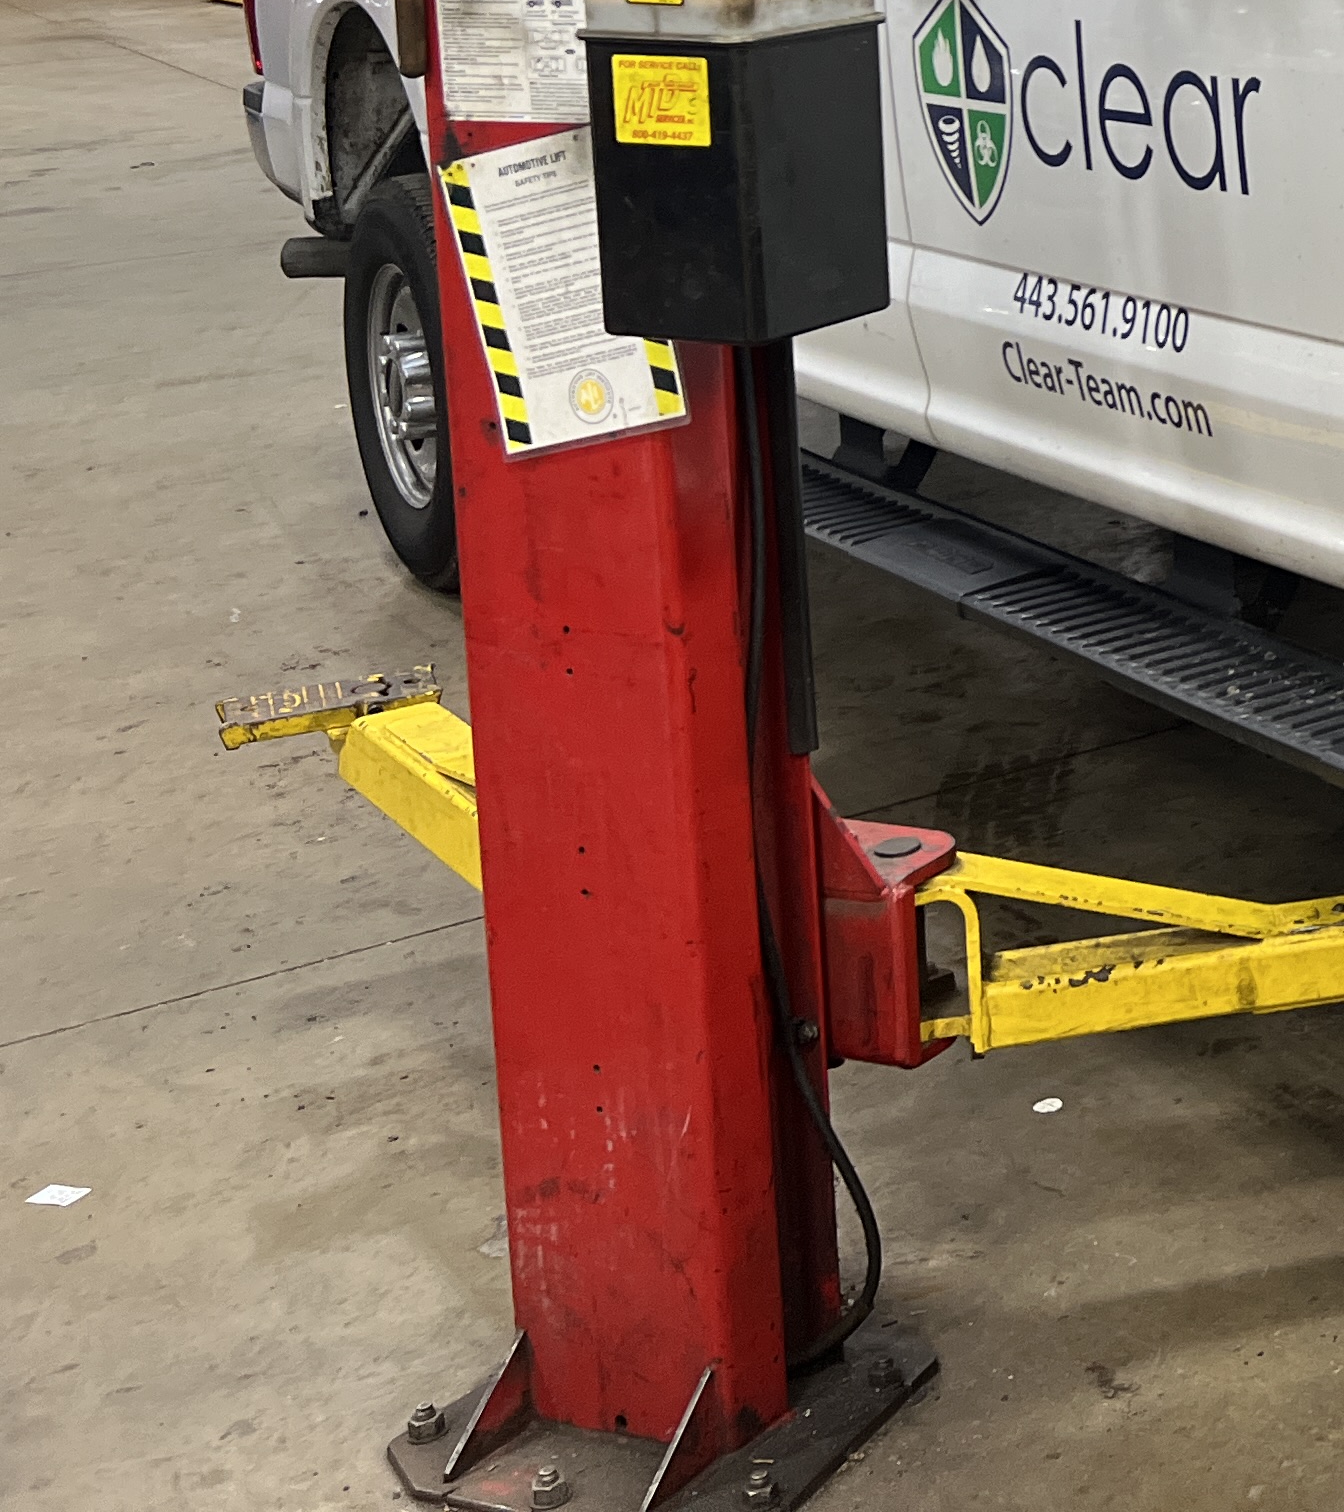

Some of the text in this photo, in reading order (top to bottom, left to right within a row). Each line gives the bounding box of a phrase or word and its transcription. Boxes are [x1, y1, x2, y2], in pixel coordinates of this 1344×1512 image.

[619, 60, 636, 69] FOR
[638, 61, 674, 70] SERVICE
[1020, 19, 1262, 196] clear
[498, 150, 567, 178] AUTOMOTIVE LIFT
[515, 170, 558, 188] SAFETY TIPS
[1012, 271, 1190, 354] 443.561.9100
[1001, 340, 1214, 438] Clear-Team.com
